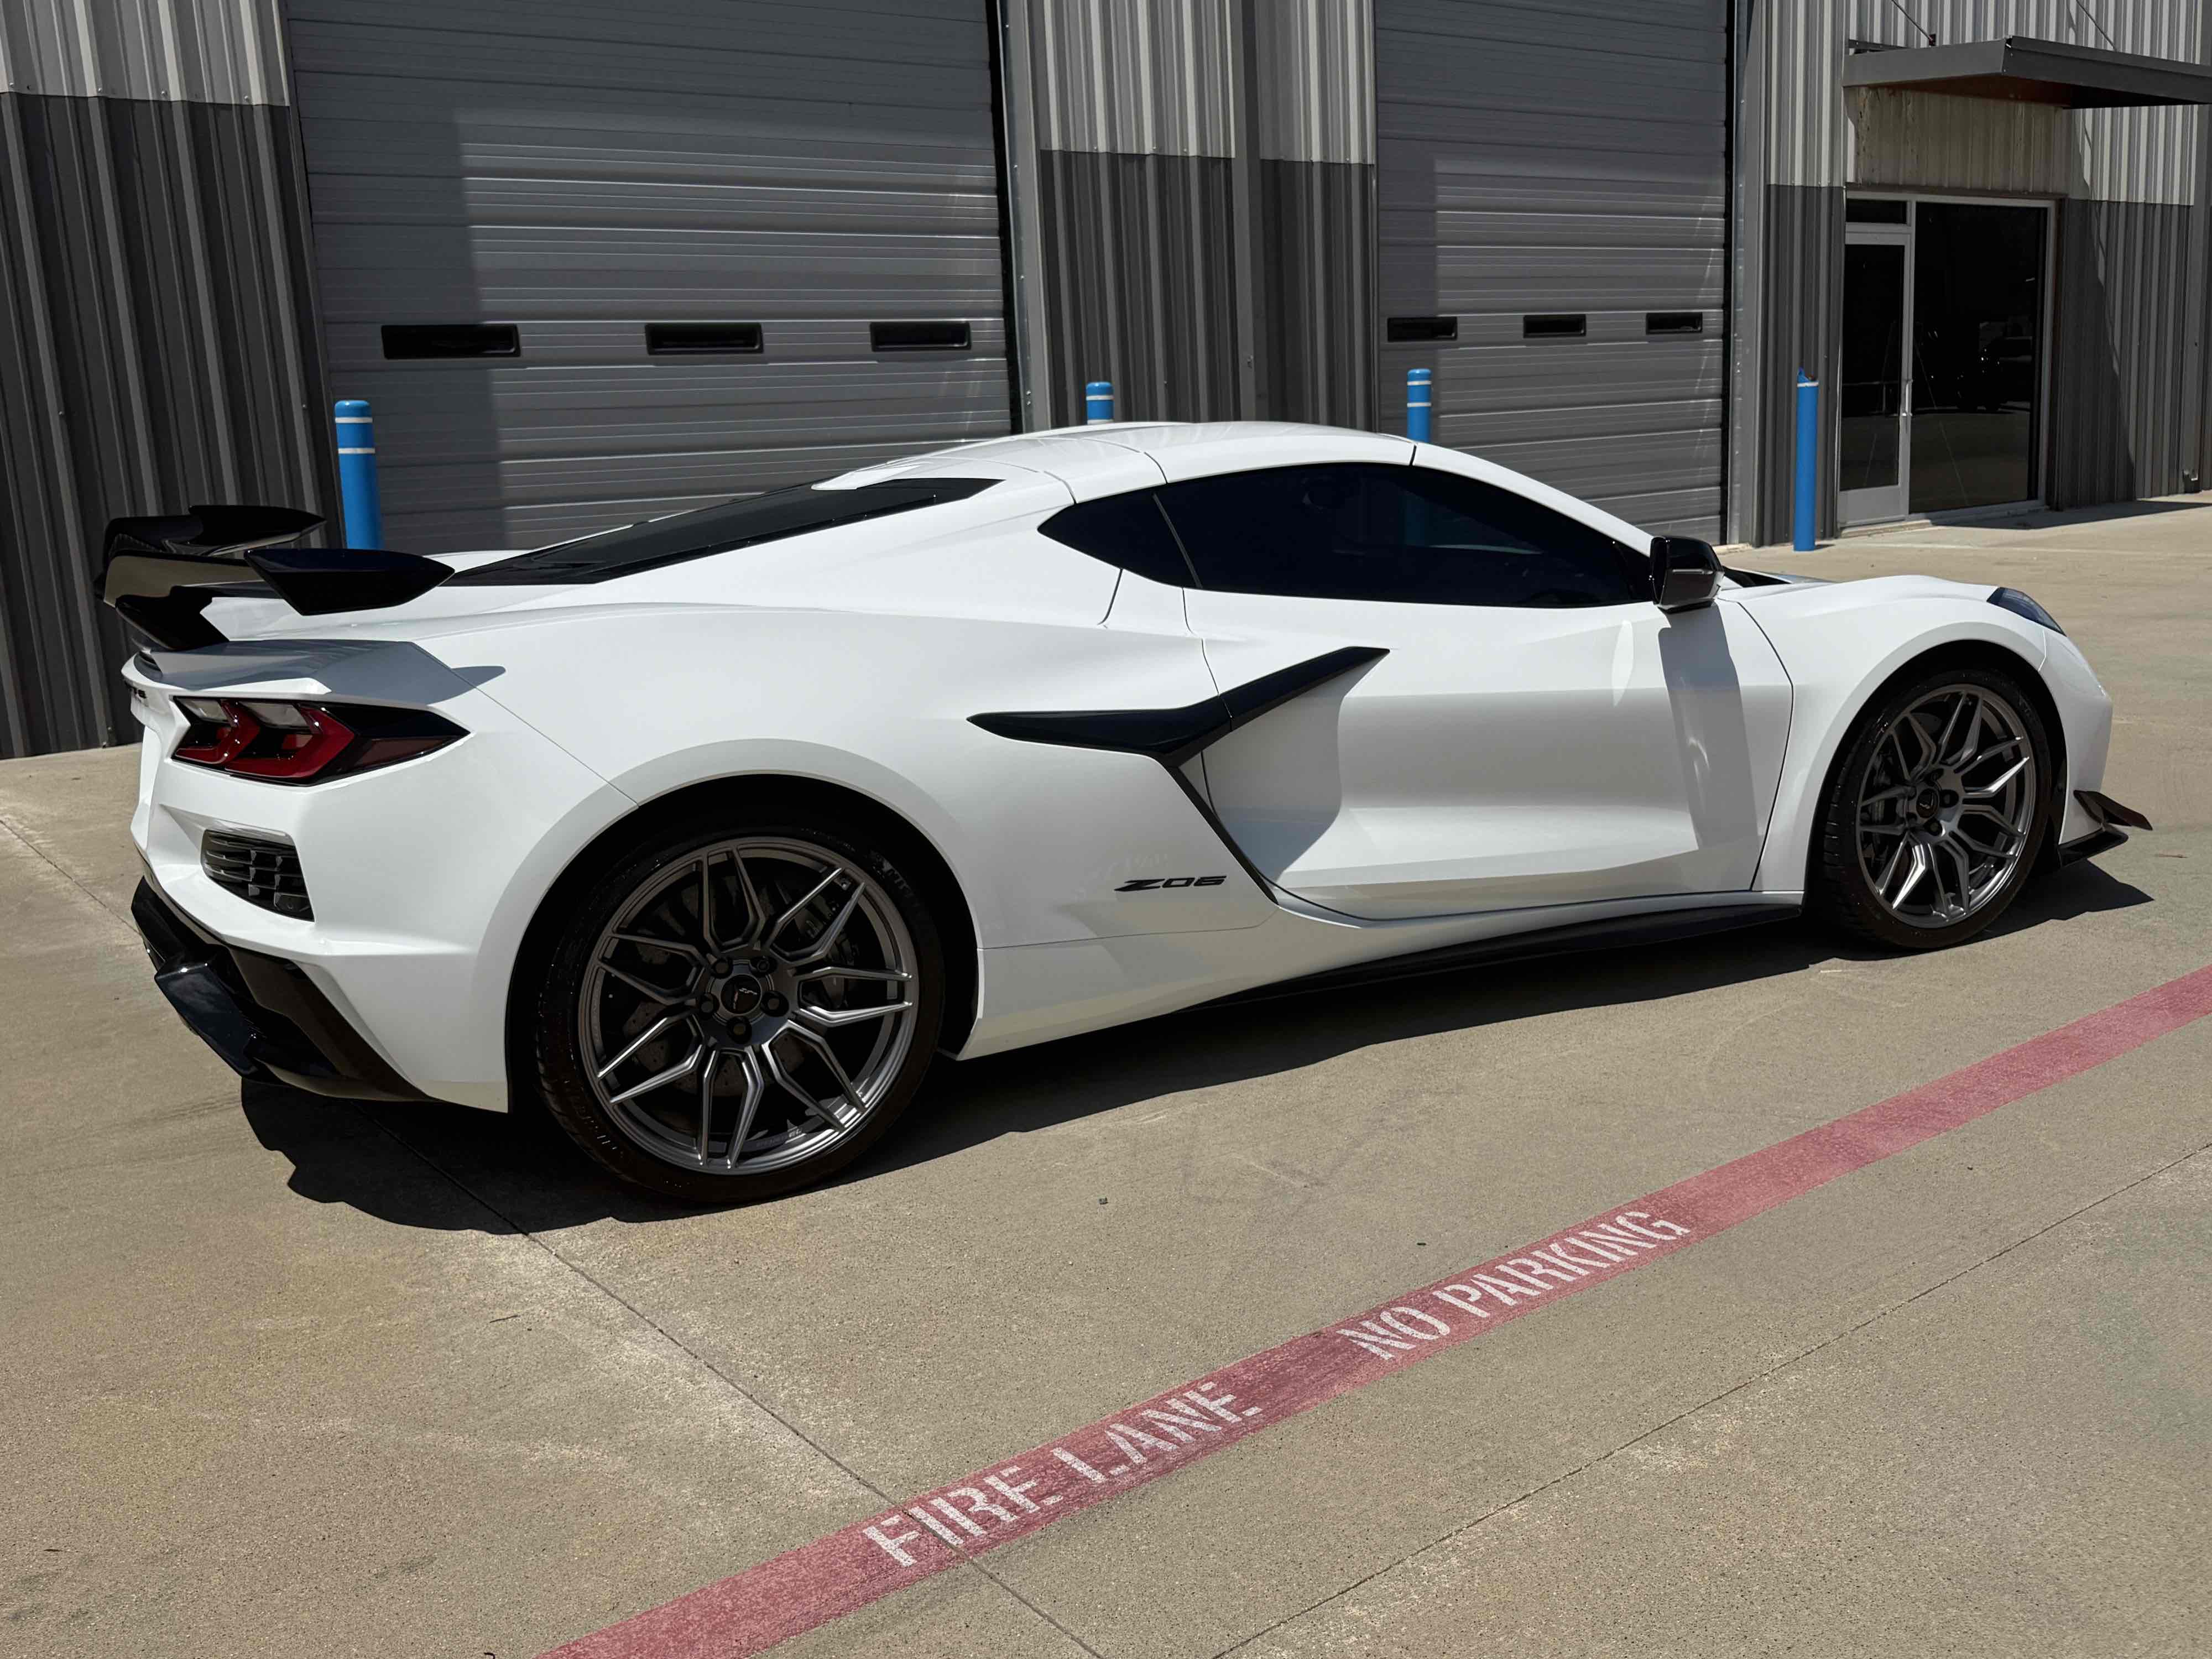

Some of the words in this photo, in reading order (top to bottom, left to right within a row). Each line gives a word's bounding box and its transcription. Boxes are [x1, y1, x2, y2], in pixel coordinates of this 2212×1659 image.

[1114, 875, 1227, 892] Z06
[862, 1466, 1063, 1567] FIRE
[1051, 1381, 1263, 1483] LANE
[1335, 1306, 1451, 1360] NO
[1432, 1212, 1691, 1318] PARKING
